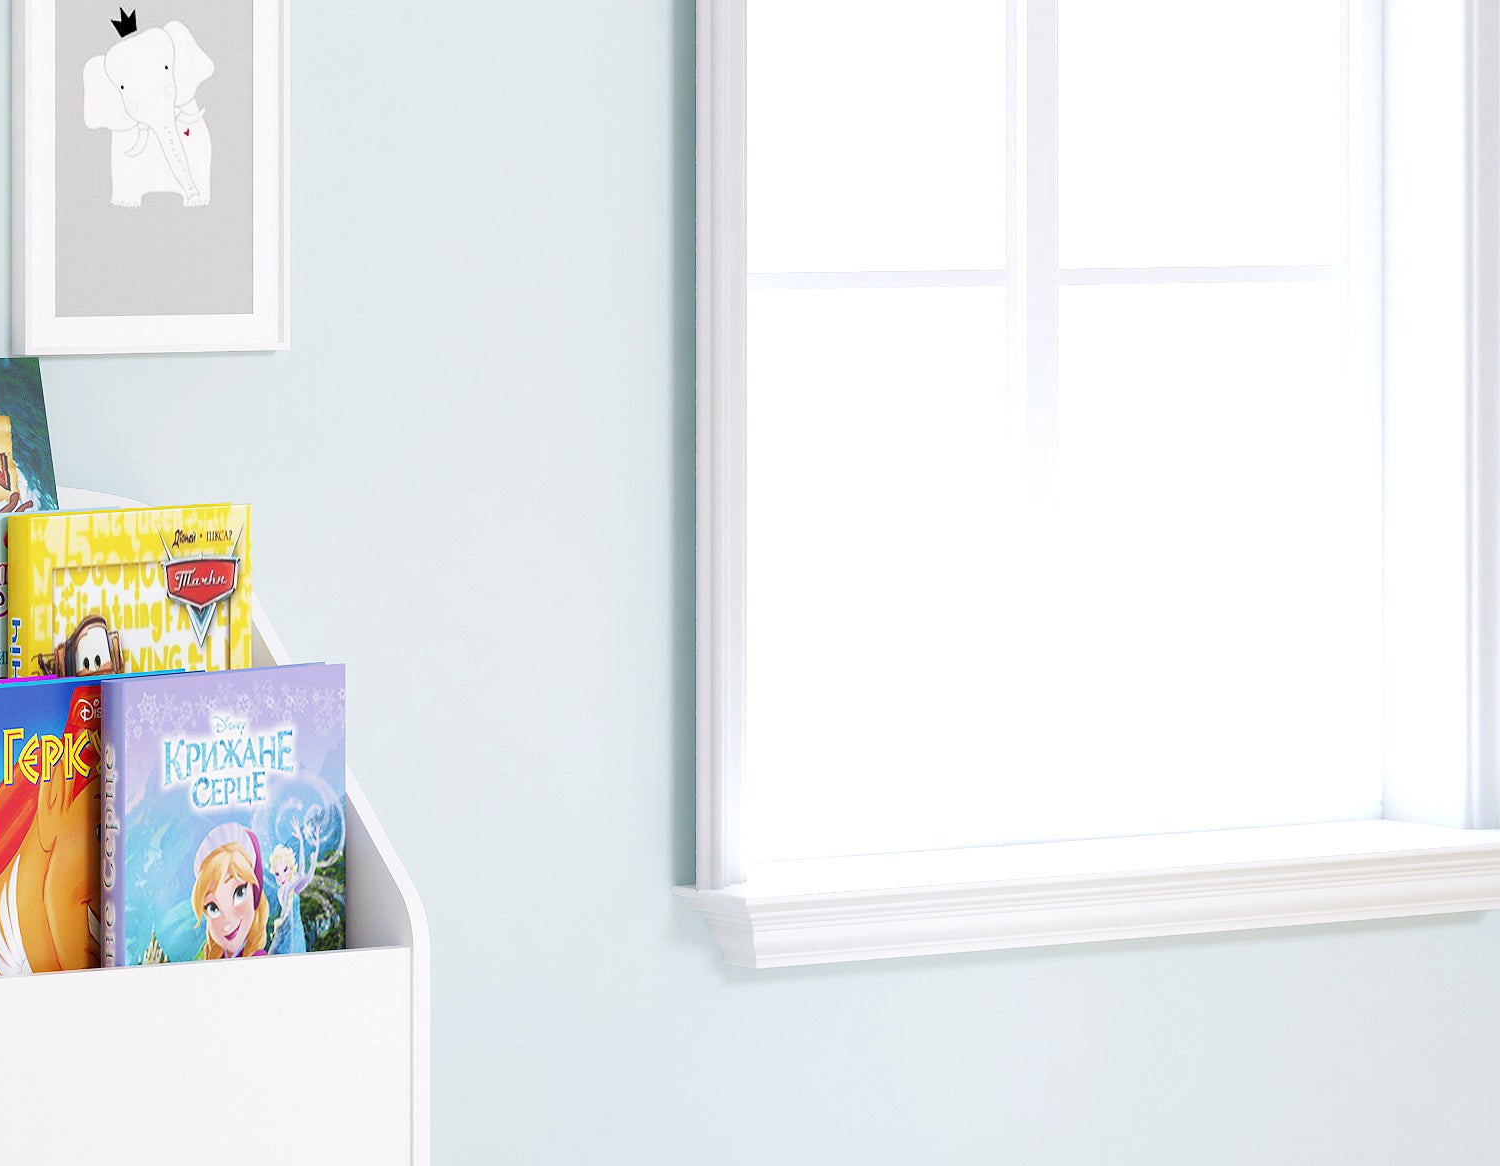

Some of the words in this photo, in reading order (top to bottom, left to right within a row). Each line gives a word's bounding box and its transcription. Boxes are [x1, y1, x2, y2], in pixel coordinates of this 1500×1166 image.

[174, 566, 227, 591] Тачки
[164, 729, 294, 786] КРИЖАНЕ
[192, 771, 266, 808] СЕРЦЕ
